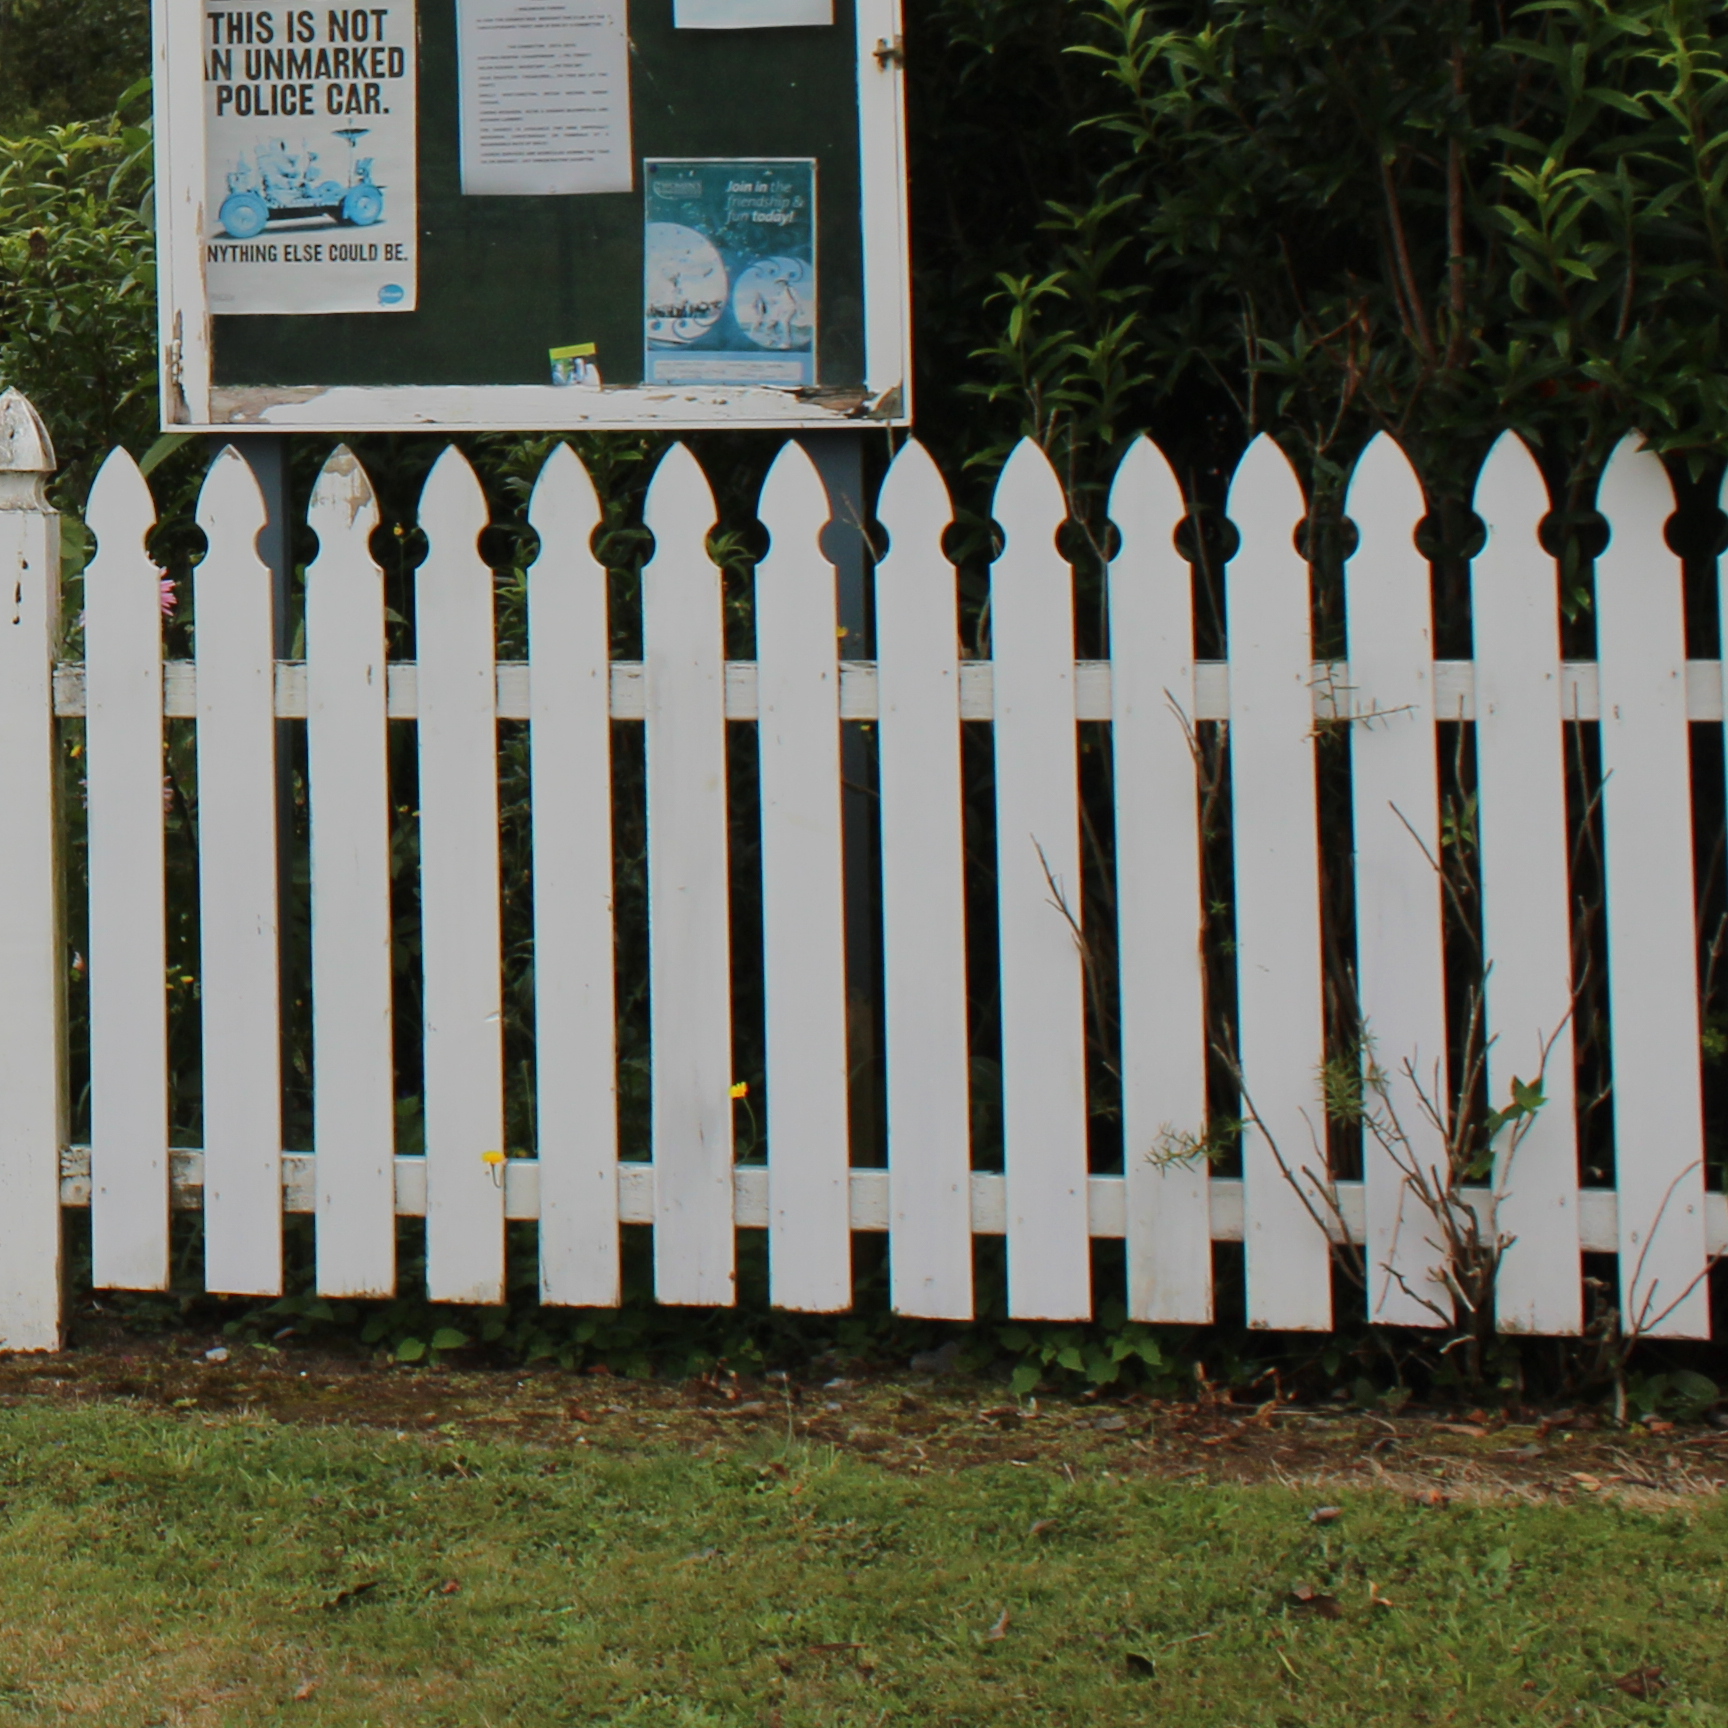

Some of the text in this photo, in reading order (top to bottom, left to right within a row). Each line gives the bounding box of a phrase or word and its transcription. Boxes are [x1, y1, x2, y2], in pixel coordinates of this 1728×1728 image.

[207, 9, 388, 44] THIS IS NOT
[204, 47, 404, 81] N UNMARKED
[217, 82, 389, 116] POLICE CAR.
[725, 180, 792, 193] Join in the
[725, 194, 804, 210] friendship &
[726, 209, 796, 226] fun today!
[207, 243, 408, 263] NYTHING ELSE COULD BE.
